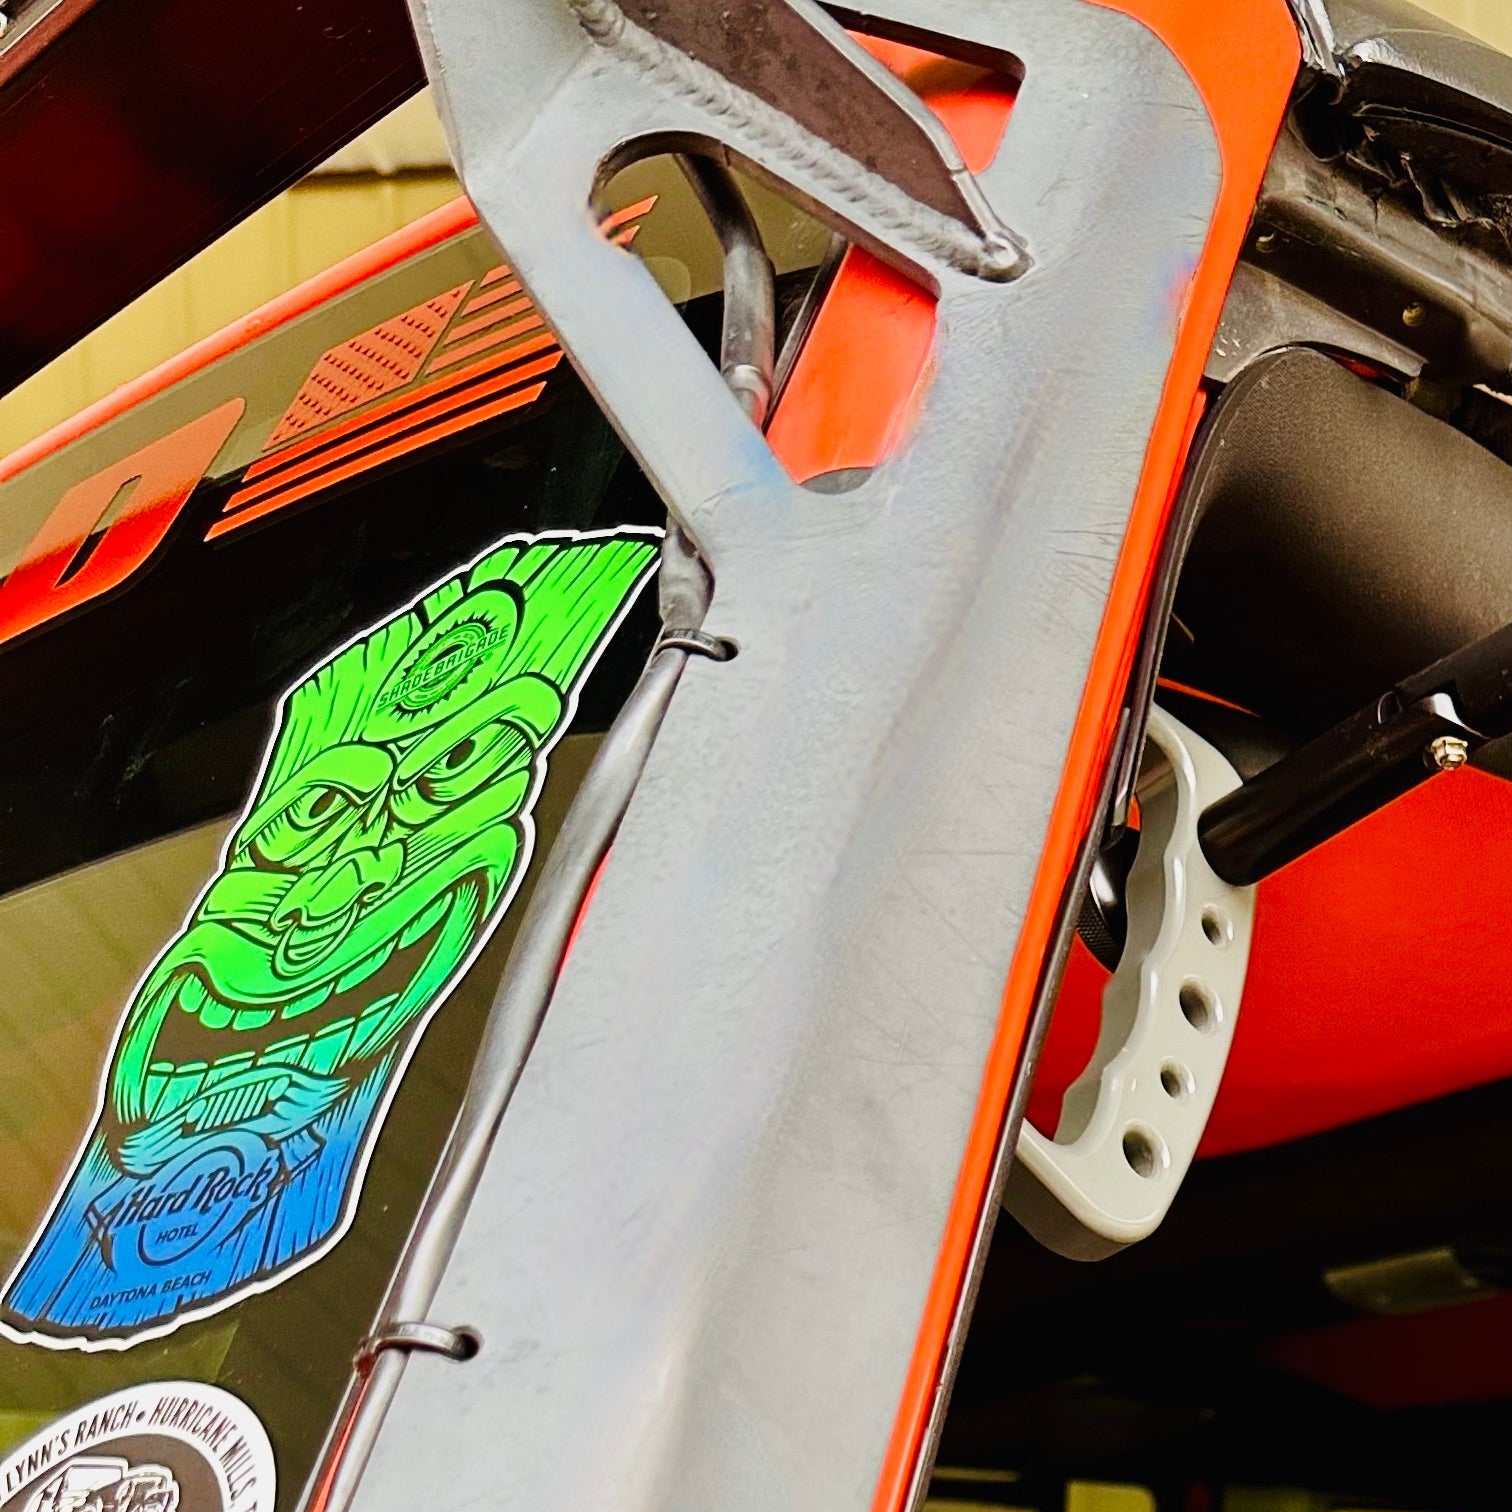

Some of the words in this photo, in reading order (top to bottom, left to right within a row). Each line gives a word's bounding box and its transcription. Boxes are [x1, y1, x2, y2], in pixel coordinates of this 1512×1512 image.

[378, 623, 512, 707] SHADEBRIGADE
[116, 1174, 201, 1227] Hard
[191, 1157, 274, 1214] Rock
[155, 1223, 200, 1245] HOTEL
[89, 1282, 160, 1311] DAYTONA
[160, 1271, 212, 1295] BEACH
[6, 1428, 71, 1493] LYNN'S
[74, 1400, 139, 1449] RANCH
[148, 1396, 238, 1454] HURRICANE
